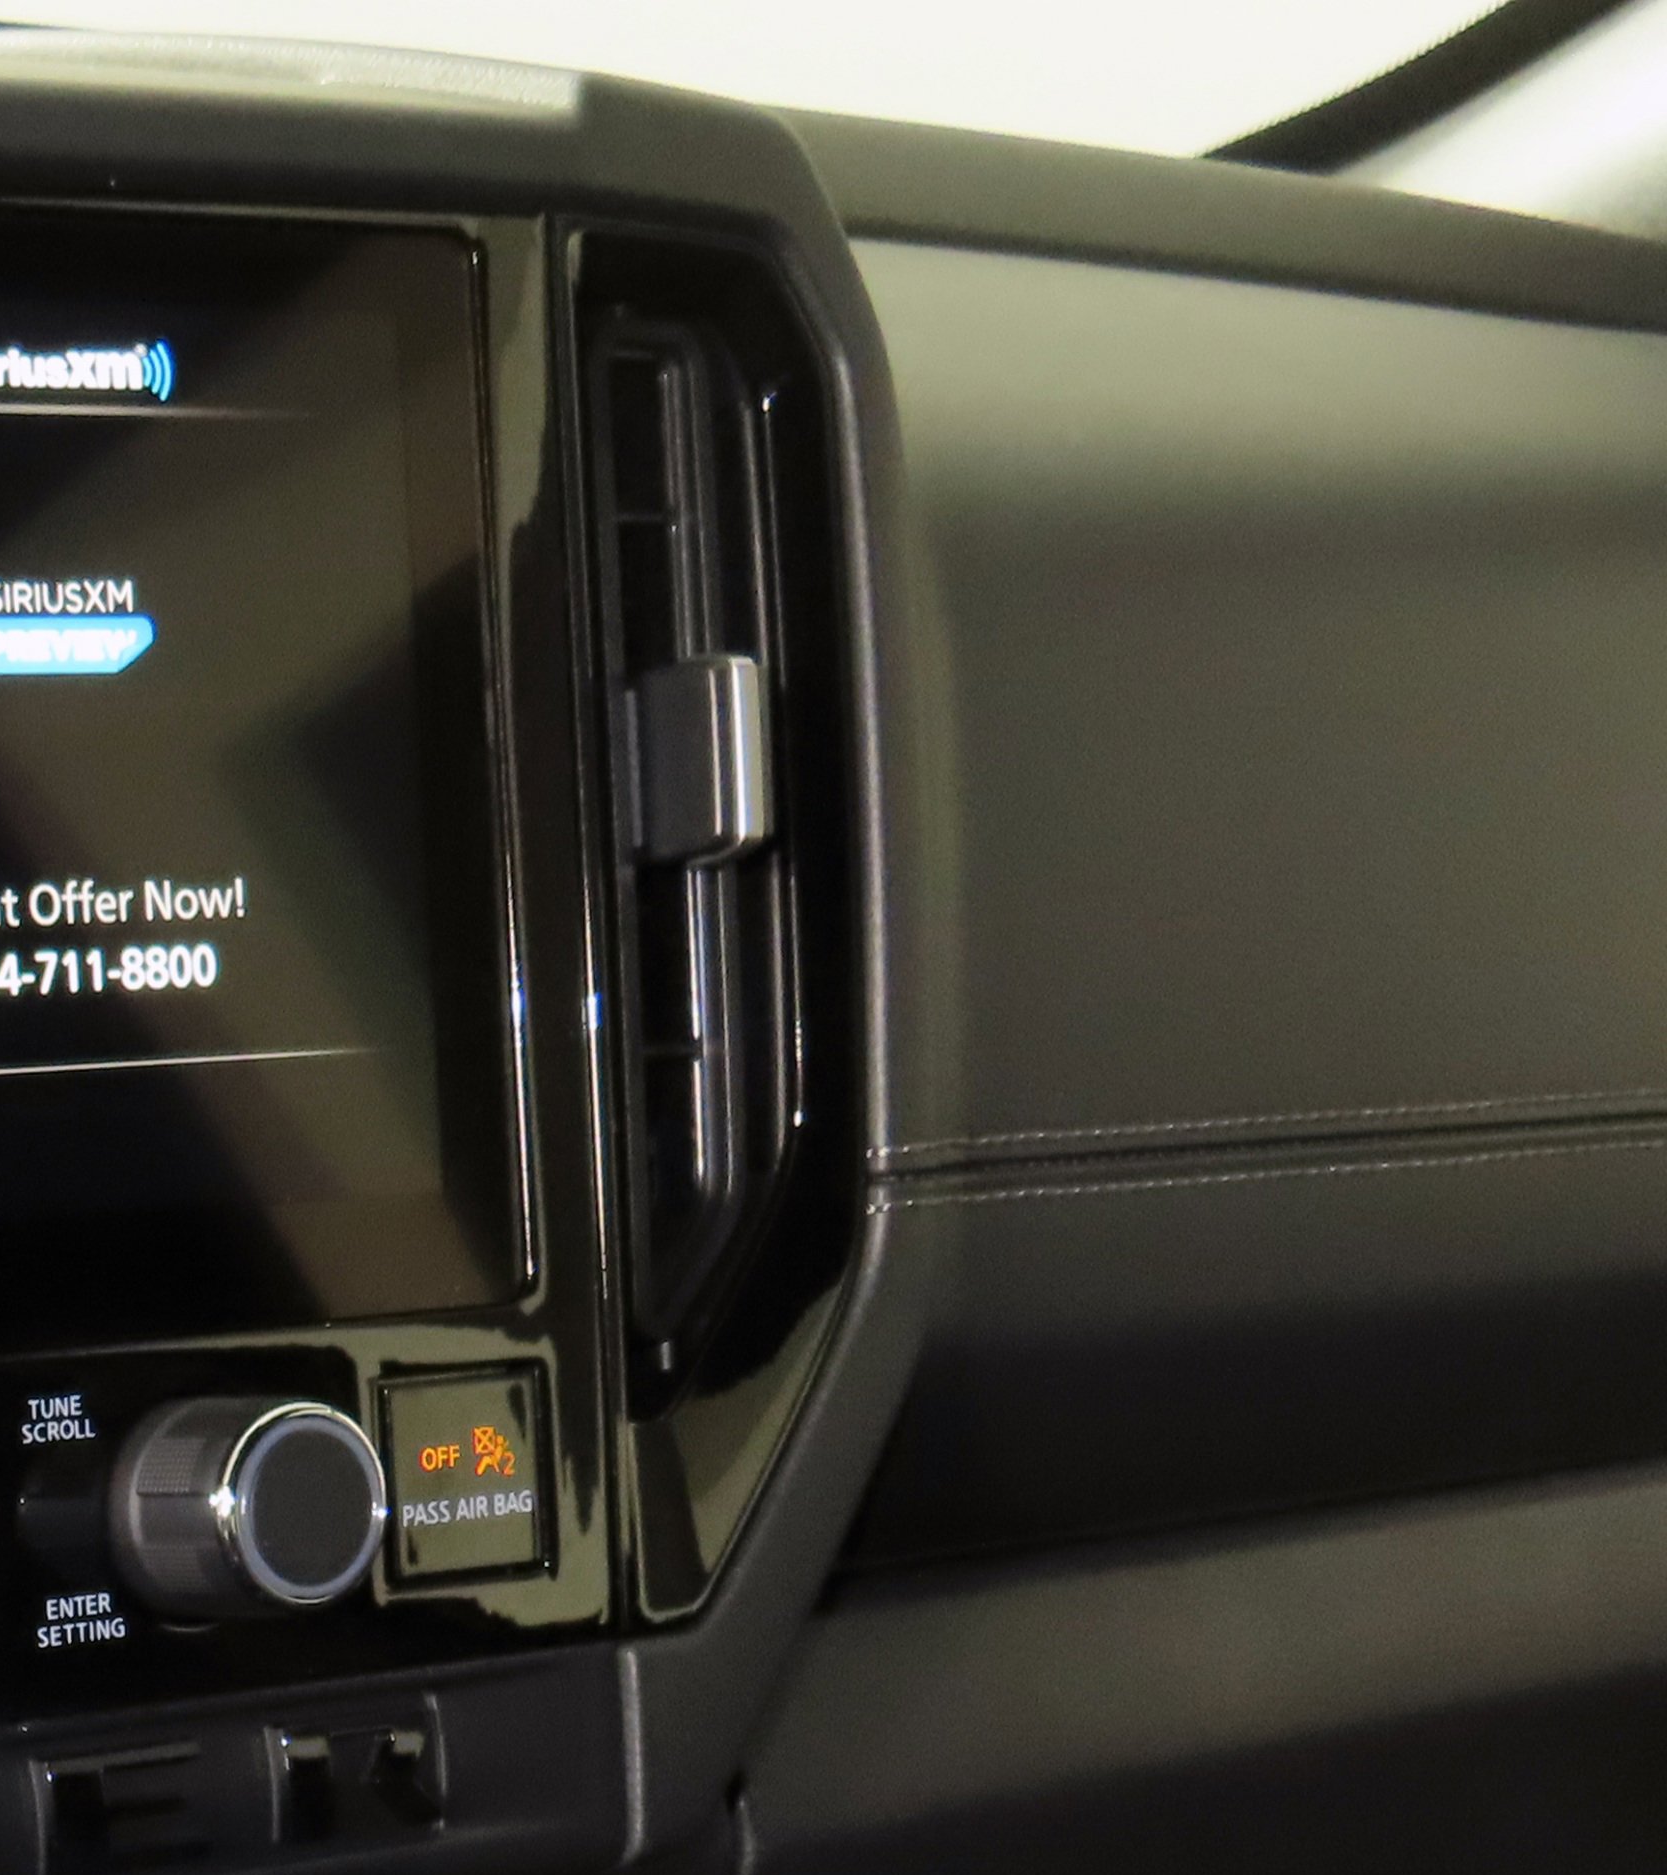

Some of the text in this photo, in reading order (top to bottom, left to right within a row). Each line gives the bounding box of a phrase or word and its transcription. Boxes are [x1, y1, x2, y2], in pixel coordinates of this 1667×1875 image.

[29, 878, 134, 926] Offer
[144, 877, 245, 922] Now!
[27, 1394, 83, 1420] TUNE
[21, 1419, 96, 1445] SCROLL
[420, 1444, 461, 1471] OFF
[402, 1489, 533, 1528] PASS AIR BAG
[46, 1592, 111, 1621] ENTER
[37, 1618, 126, 1649] SETTING
